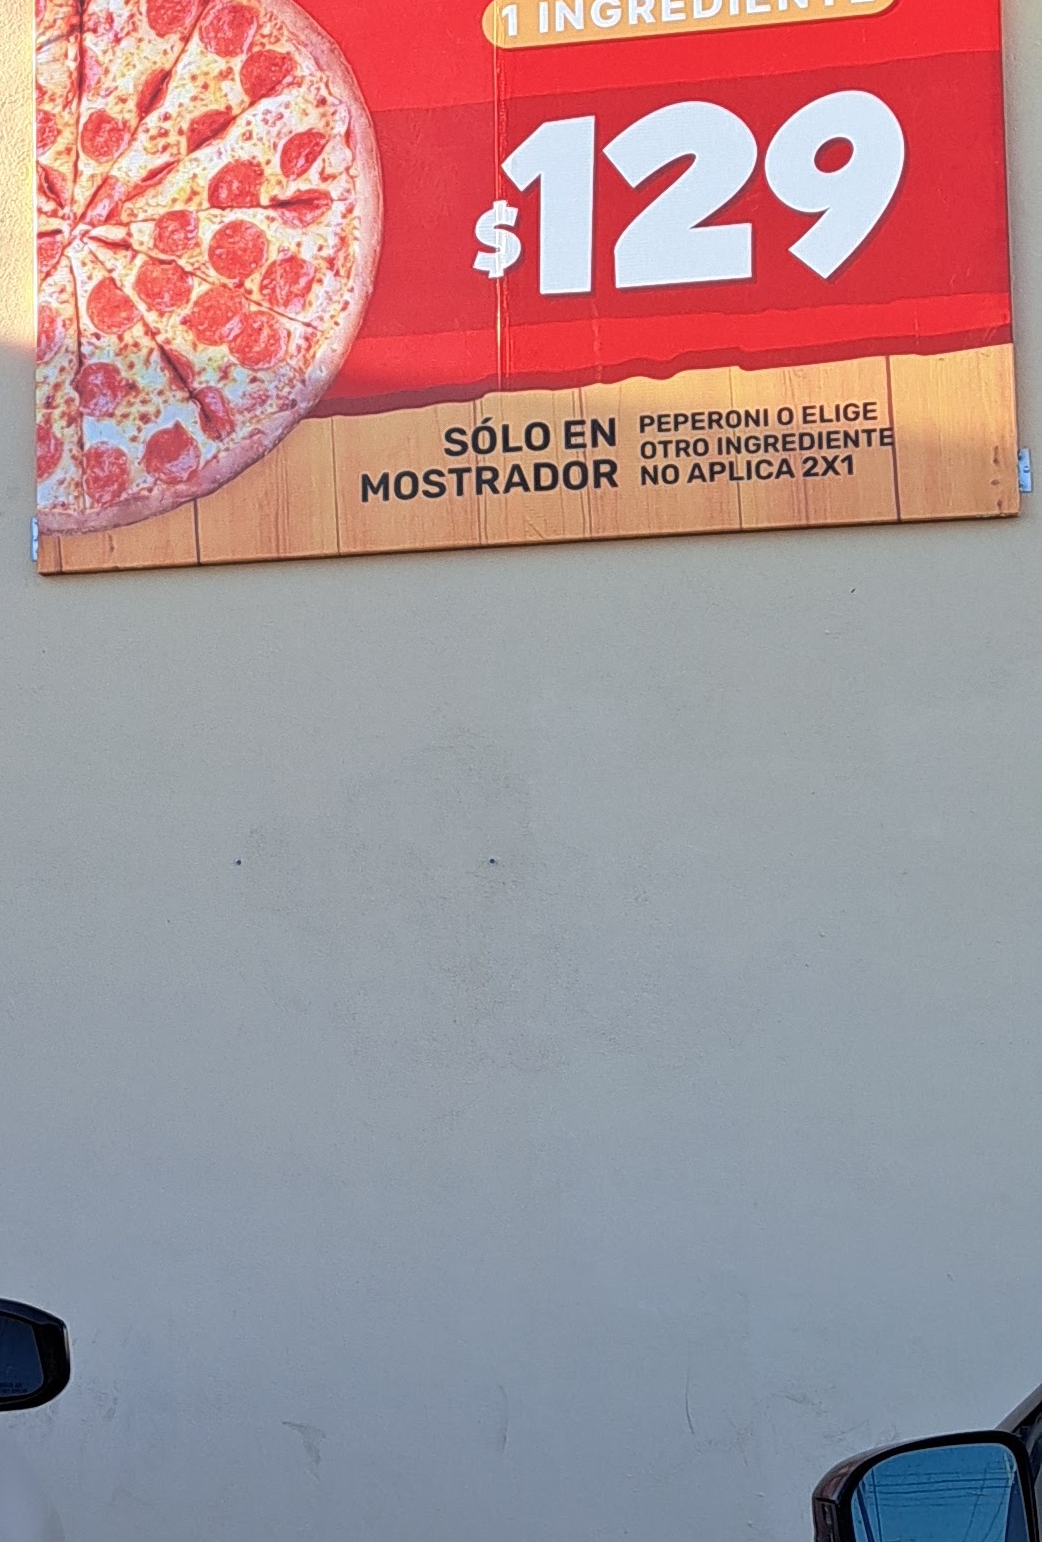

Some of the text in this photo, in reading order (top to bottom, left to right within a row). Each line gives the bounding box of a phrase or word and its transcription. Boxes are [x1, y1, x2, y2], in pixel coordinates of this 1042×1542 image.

[501, 3, 518, 36] 1
[472, 90, 905, 295] $129
[639, 401, 878, 434] PEPERONI O ELIGE
[443, 416, 616, 457] SÓLO EN
[640, 427, 893, 460] OTRO INGREDIENTE
[361, 458, 619, 503] MOSTRADOR
[640, 454, 854, 486] NO APLICA 2X1
